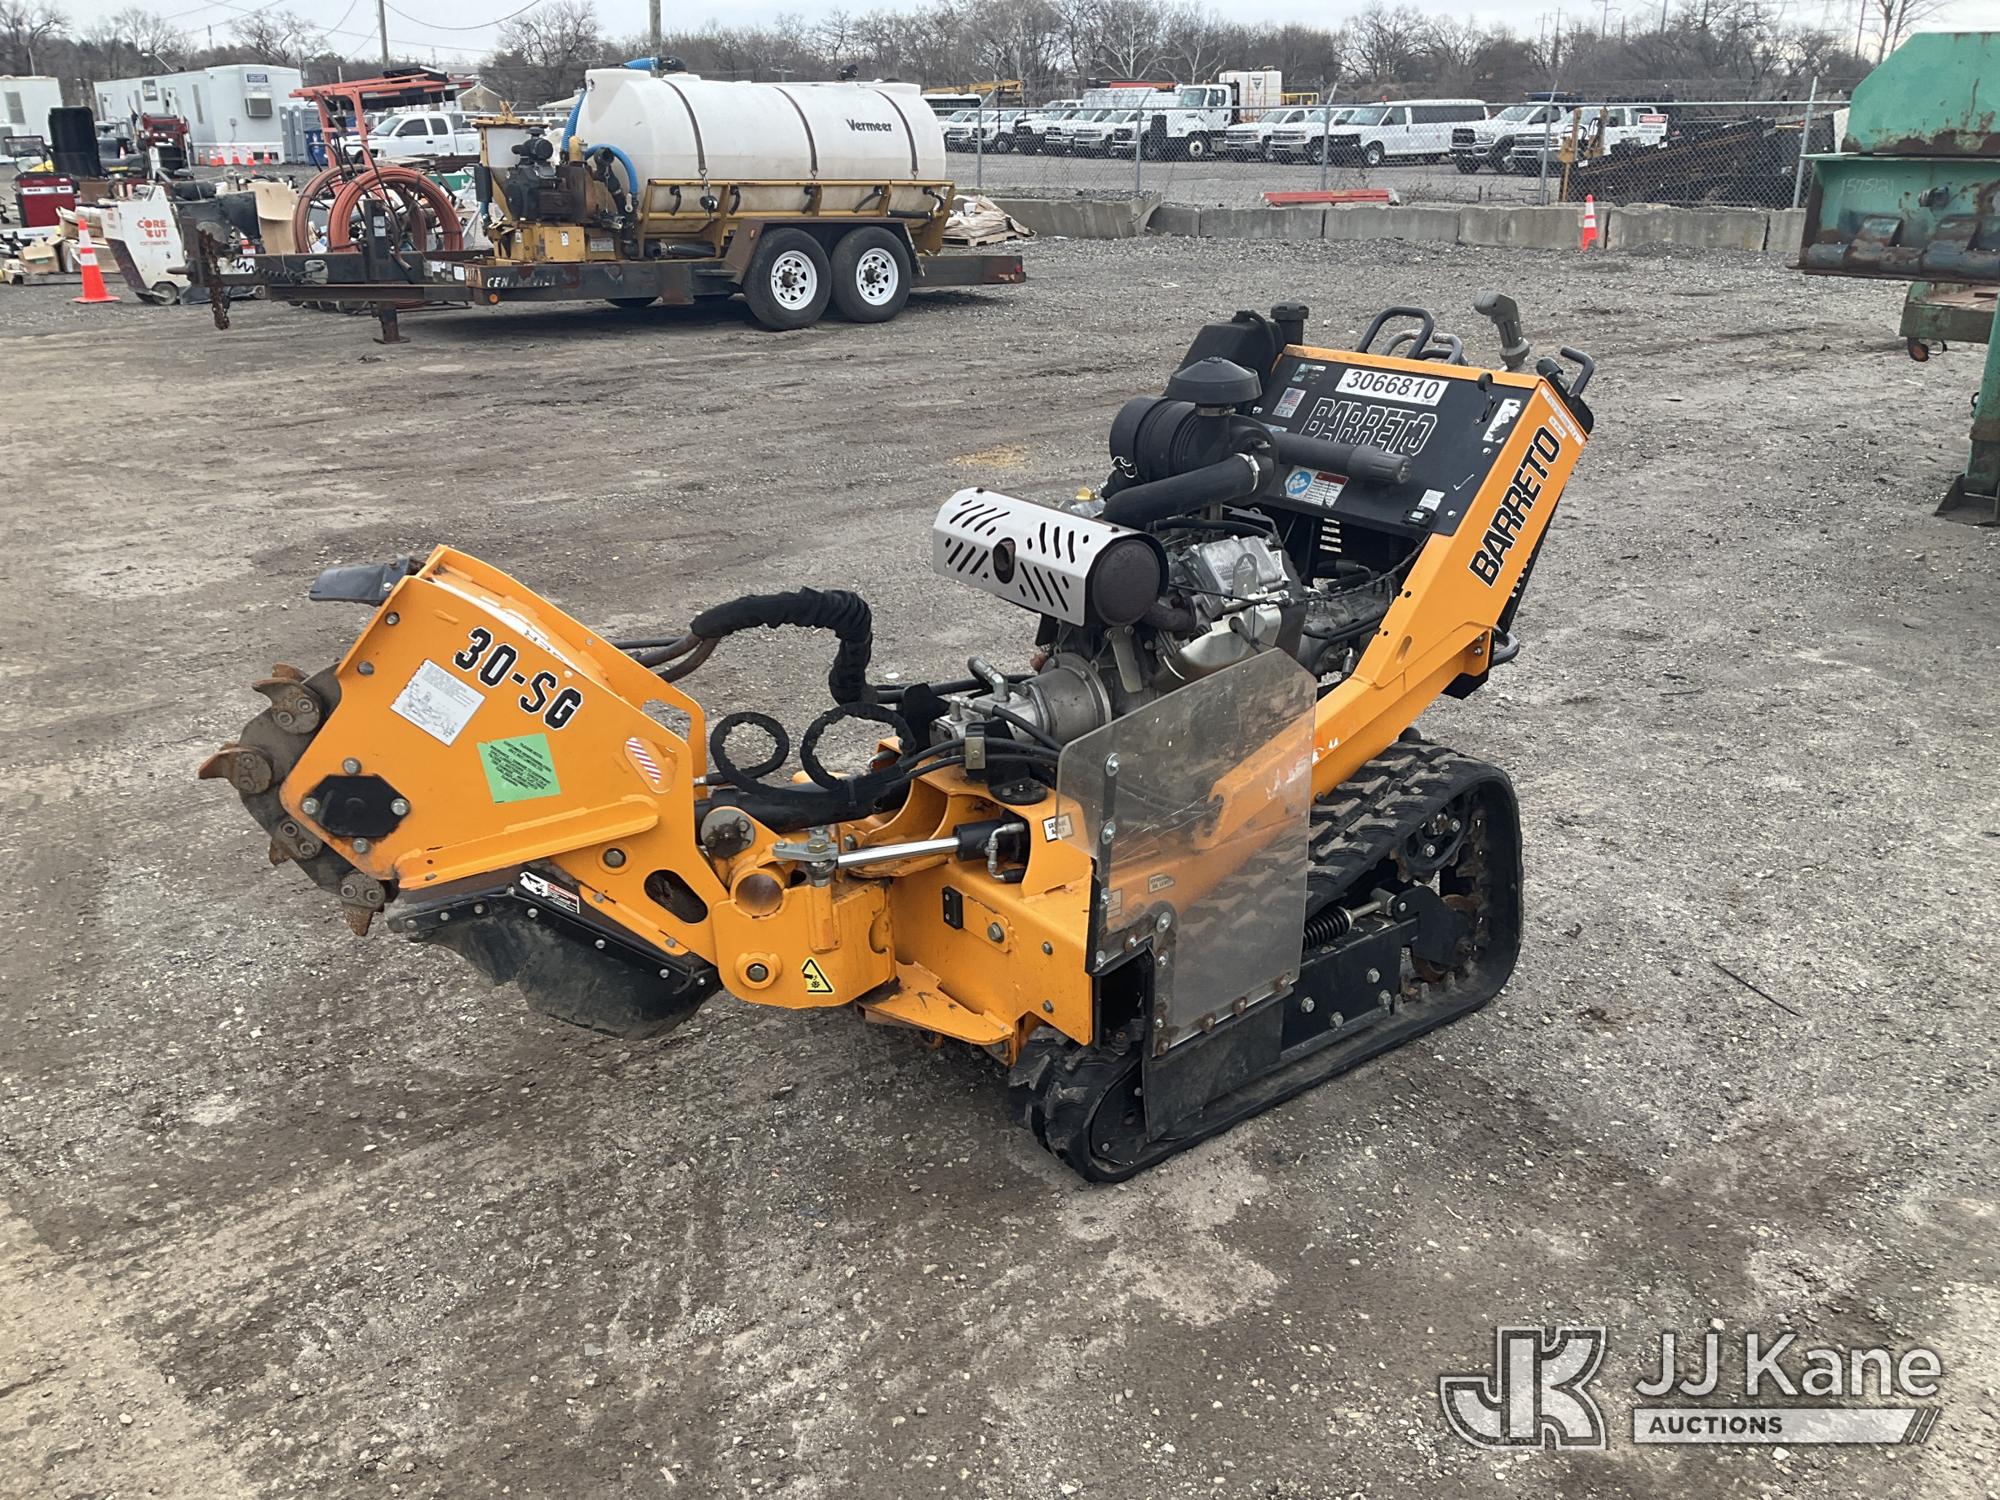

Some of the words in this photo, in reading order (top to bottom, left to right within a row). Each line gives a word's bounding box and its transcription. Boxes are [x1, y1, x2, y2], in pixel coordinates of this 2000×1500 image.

[845, 119, 892, 132] Vermeer
[136, 219, 167, 229] CORE
[1346, 370, 1440, 400] 3066810
[1300, 396, 1438, 457] BARRETO
[1468, 425, 1561, 588] BARRETO
[453, 626, 583, 730] 30-SG
